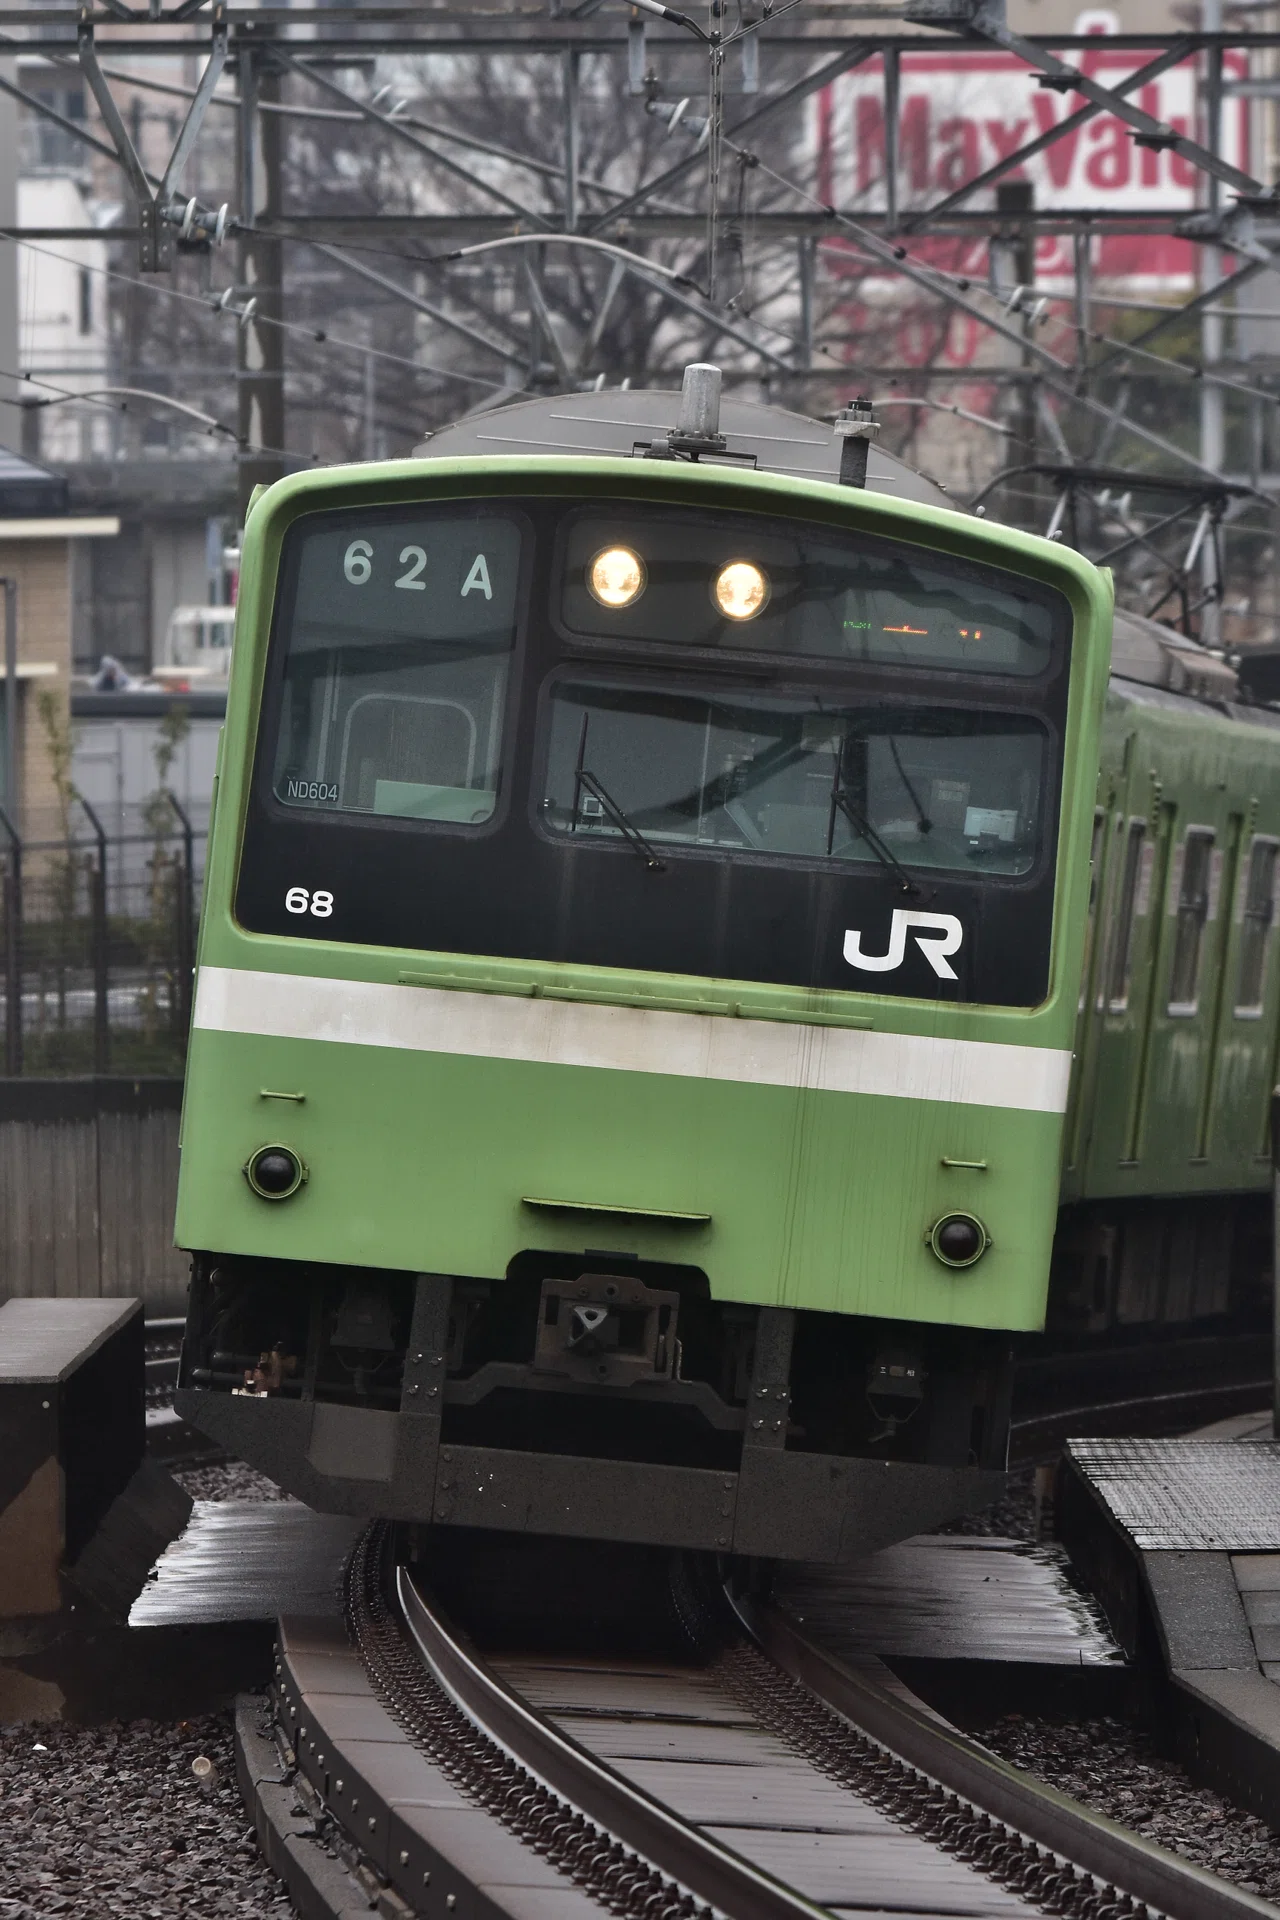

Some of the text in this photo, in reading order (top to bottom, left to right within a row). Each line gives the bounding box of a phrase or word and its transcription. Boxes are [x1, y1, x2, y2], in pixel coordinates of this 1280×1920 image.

[287, 780, 338, 802] ND604
[284, 886, 335, 918] 68
[842, 908, 964, 980] JR
